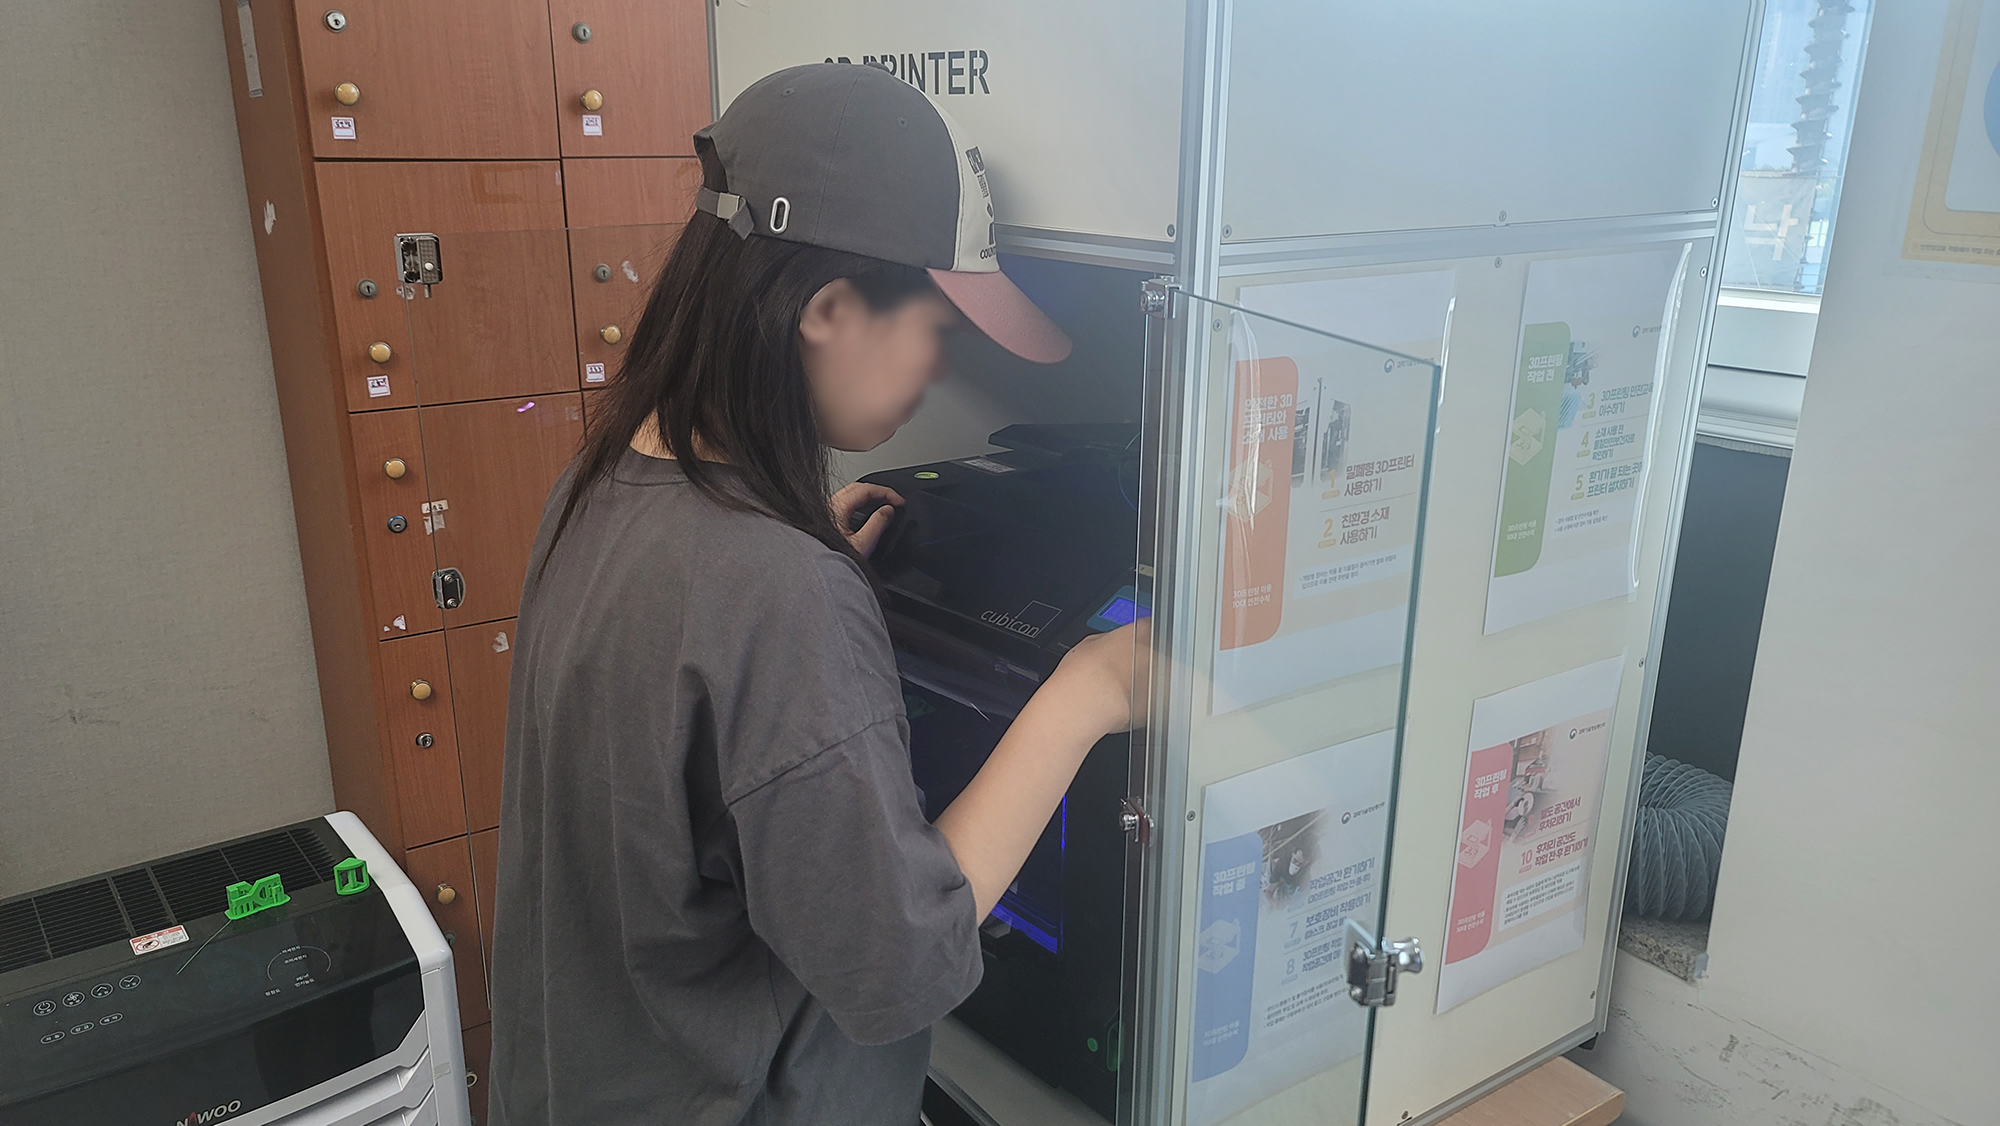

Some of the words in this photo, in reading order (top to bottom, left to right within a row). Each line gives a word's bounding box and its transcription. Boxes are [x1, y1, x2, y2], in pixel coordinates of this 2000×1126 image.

[863, 50, 990, 95] INTER
[1529, 354, 1563, 369] 3D프린팅
[1527, 370, 1545, 383] 작업
[1546, 369, 1555, 381] 전
[1280, 394, 1293, 408] 3D
[1587, 392, 1595, 409] 3
[1601, 388, 1629, 401] 3D프린팅
[1599, 401, 1625, 416] 이수하기
[1267, 426, 1288, 441] 사용
[1581, 431, 1589, 447] 4
[1592, 449, 1614, 460] 확인하기
[1346, 461, 1375, 480] 밀폐형
[1375, 454, 1415, 474] 3D프린터
[1589, 468, 1610, 483] 환기가
[1610, 467, 1617, 479] 잘
[1617, 465, 1631, 476] 되는
[1344, 477, 1382, 497] 사용하기
[1575, 474, 1583, 491] 5
[1587, 482, 1608, 497] 프린터
[1608, 477, 1635, 493] 설치하기
[1341, 510, 1370, 529] 친환경
[1370, 506, 1390, 523] 소재
[1323, 518, 1333, 538] 2
[1340, 525, 1378, 545] 사용하기
[981, 611, 1040, 638] cubicon
[1475, 769, 1507, 788] 3D프린팅
[1474, 786, 1490, 799] 작업
[1491, 783, 1499, 794] 후
[1554, 796, 1581, 814] 공간에서
[1539, 811, 1572, 831] 후처리하기
[1535, 853, 1548, 866] 작업
[1564, 836, 1588, 857] 환기하기
[1536, 838, 1556, 855] 후처리
[1556, 831, 1576, 847] 공간도
[1521, 849, 1533, 865] 10
[1213, 861, 1256, 884] 3D프린팅
[1310, 869, 1343, 890] 작업공간
[1344, 857, 1375, 879] 환기하기
[1213, 881, 1234, 896] 작업
[1305, 905, 1339, 928] 보호장비
[1340, 892, 1371, 913] 착용하기
[1290, 921, 1298, 938] 7
[1286, 959, 1295, 975] 8
